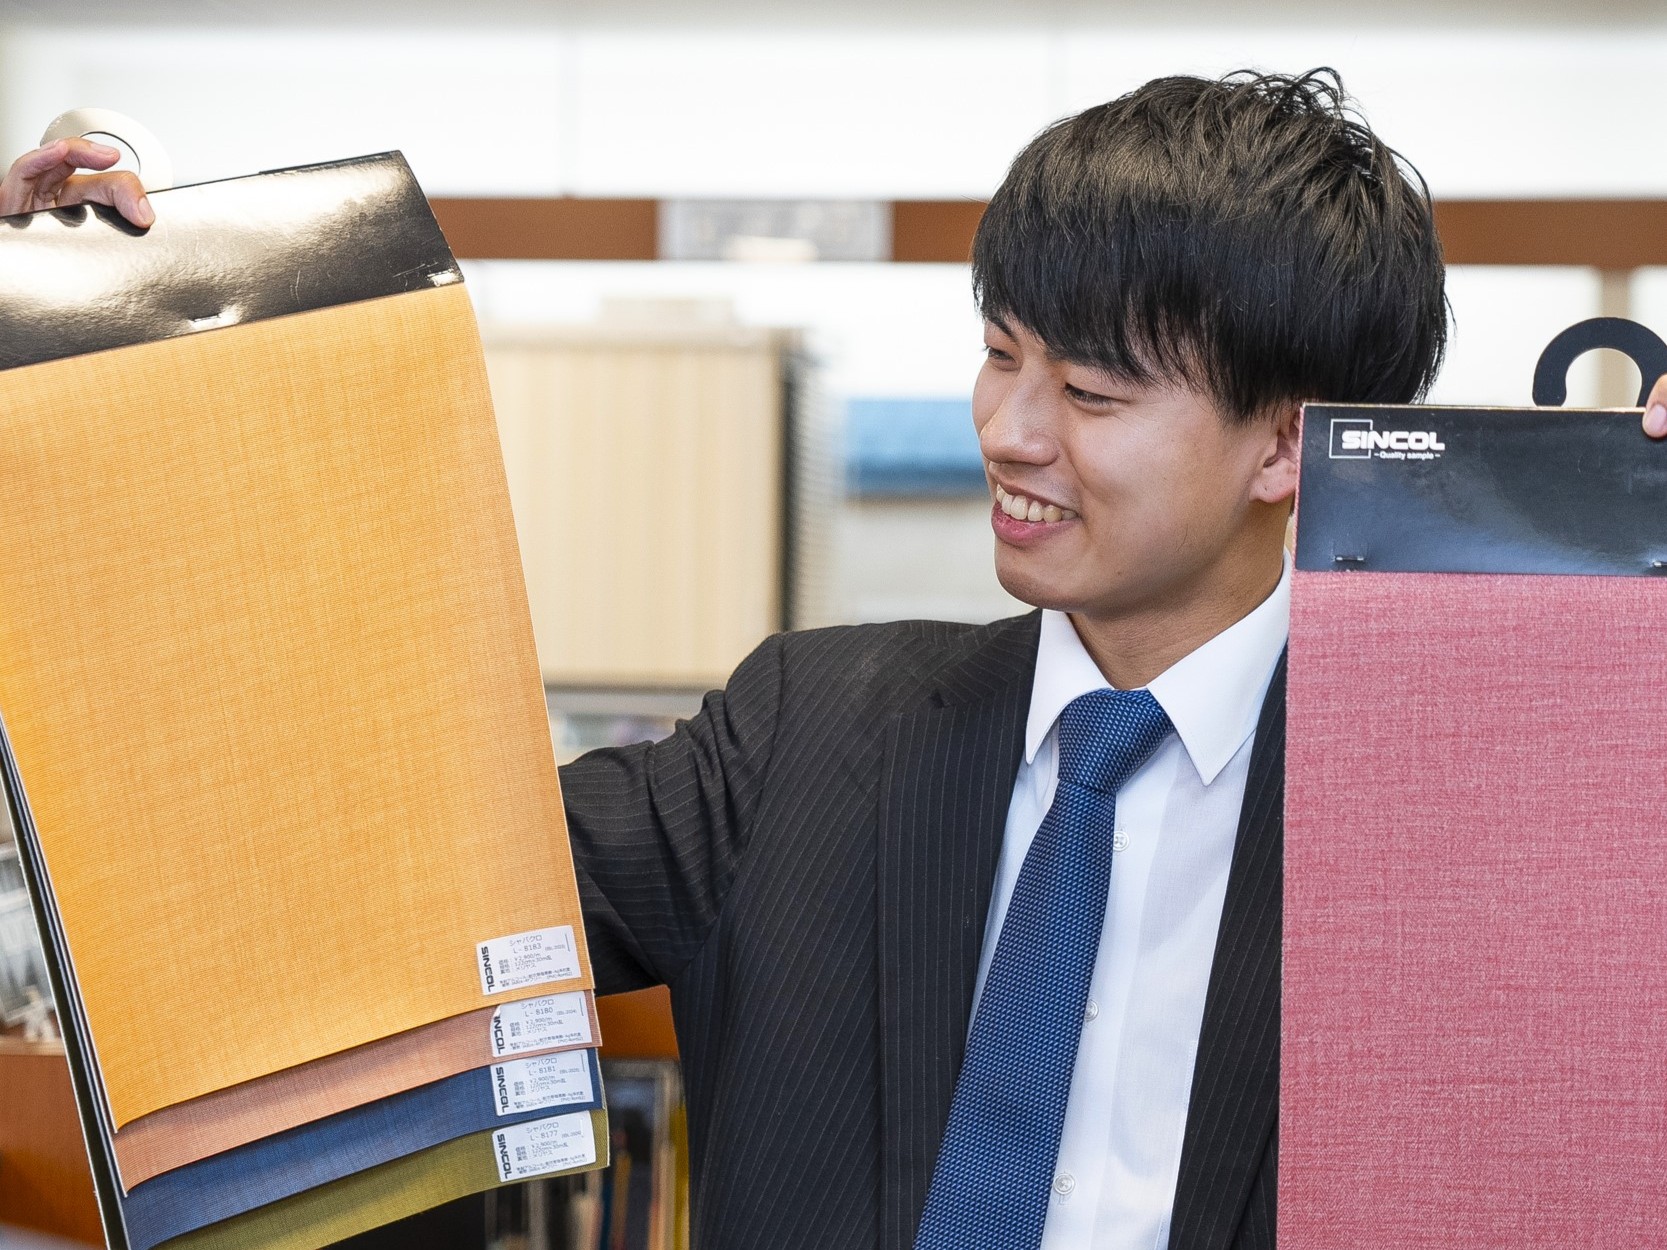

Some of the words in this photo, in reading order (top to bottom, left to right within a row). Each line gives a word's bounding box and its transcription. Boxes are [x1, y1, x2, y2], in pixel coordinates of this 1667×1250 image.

[1341, 430, 1445, 450] SINCOL
[481, 946, 495, 992] SINCOL
[493, 1014, 505, 1054] INCOL
[496, 1066, 509, 1113] SINCOL
[497, 1133, 512, 1179] SINCOL
